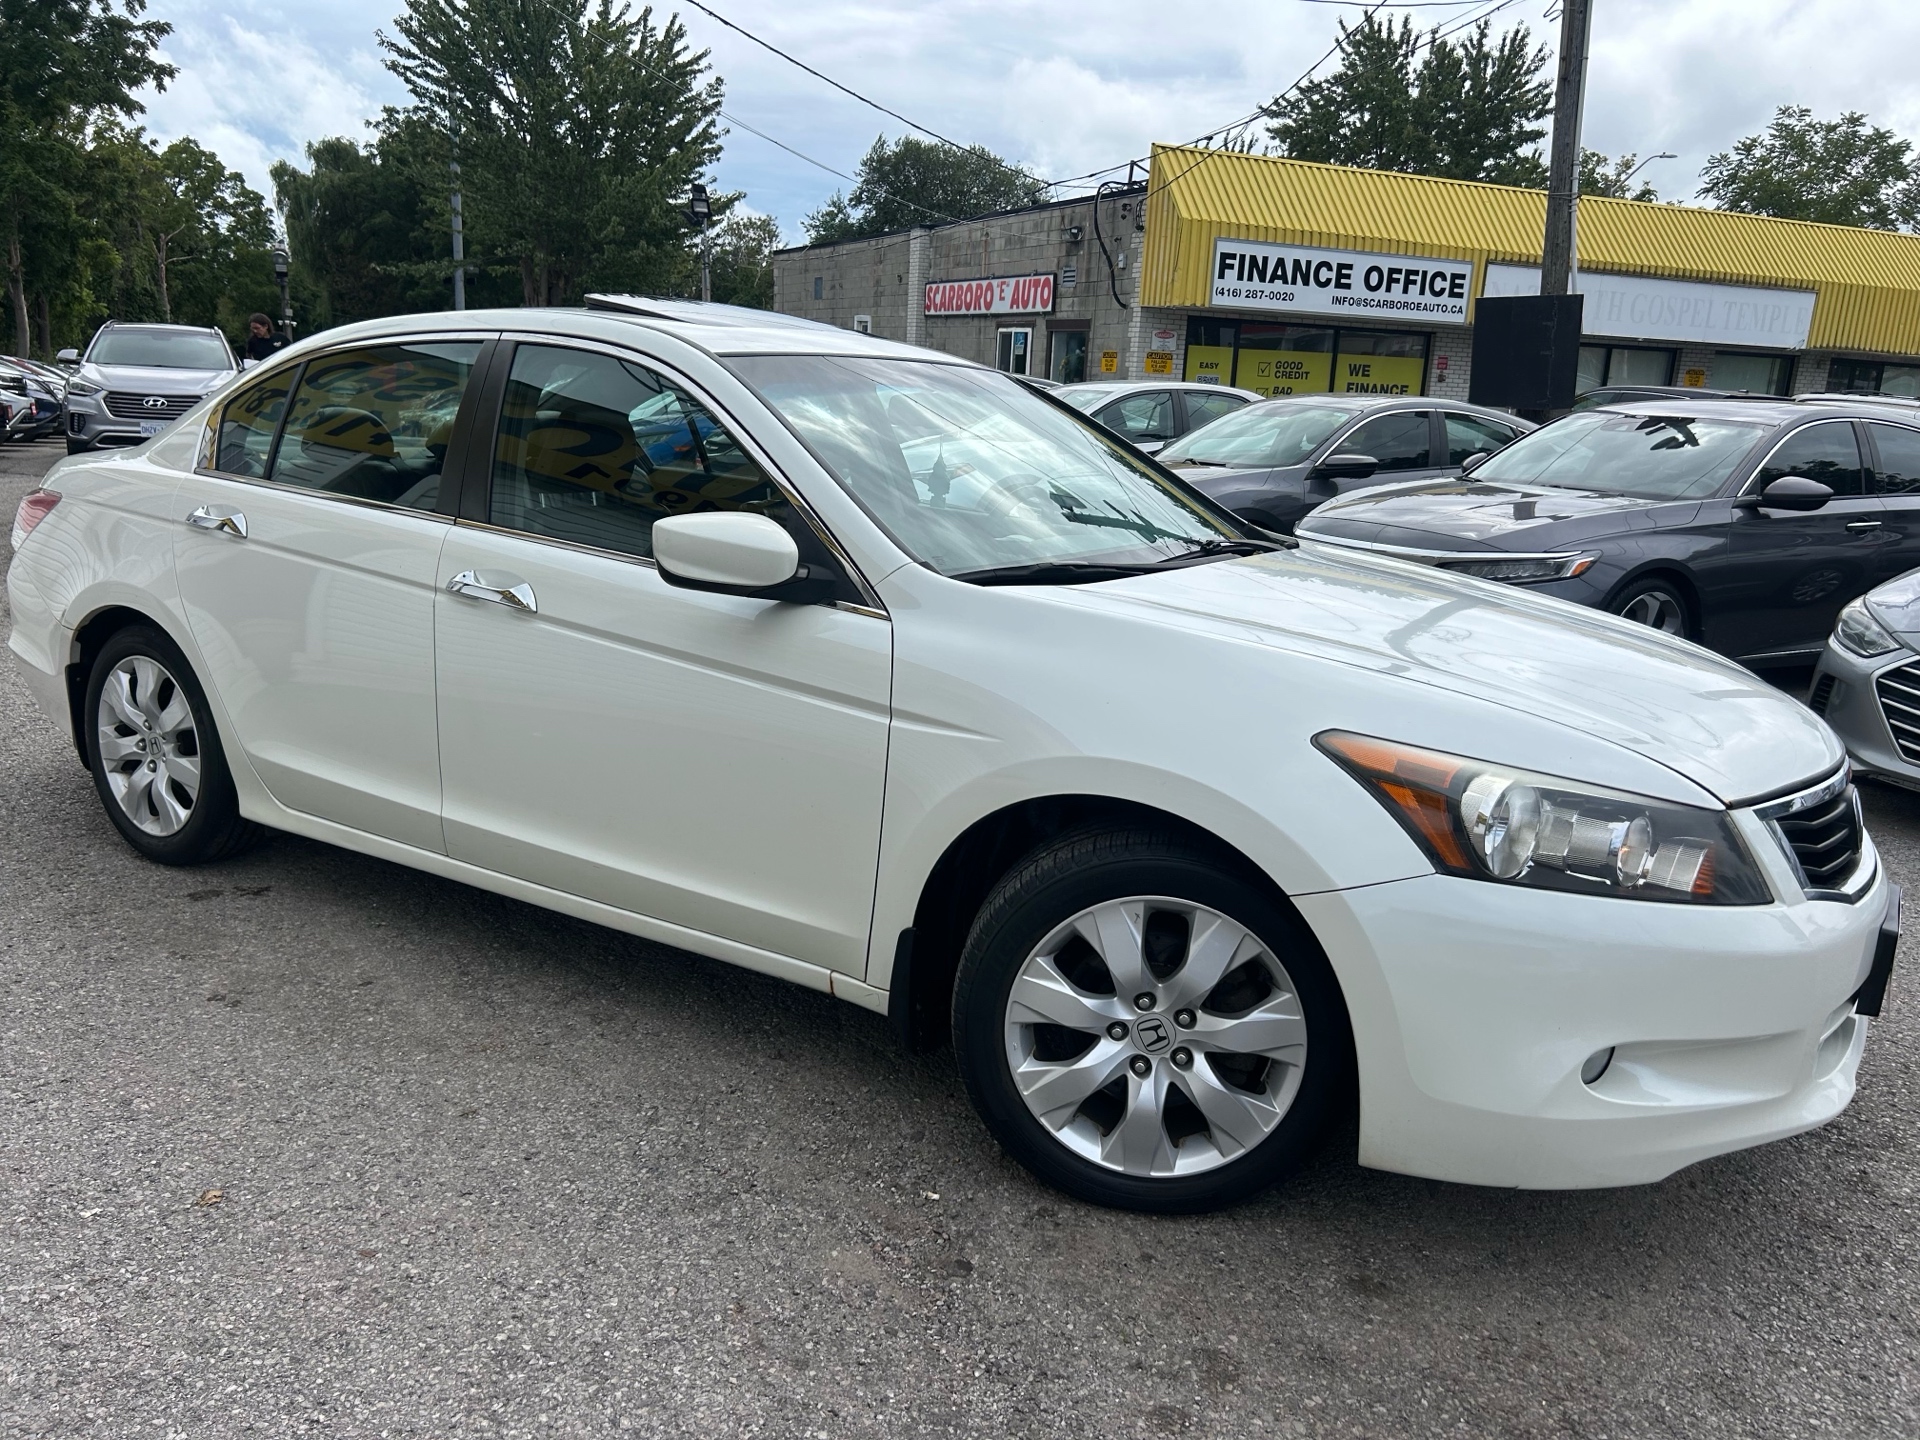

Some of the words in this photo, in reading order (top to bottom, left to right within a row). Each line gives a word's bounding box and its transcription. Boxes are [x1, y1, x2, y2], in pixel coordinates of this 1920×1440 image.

[1217, 252, 1354, 290] FINANCE
[1363, 265, 1467, 299] OFFICE
[925, 281, 994, 313] SCARBORO
[1009, 276, 1053, 310] AUTO
[1215, 286, 1242, 298] (416)
[1244, 288, 1295, 302] 287-0020
[1331, 295, 1464, 314] INFO@SCARBOROEAUTO.CA
[1723, 300, 1808, 336] TEMPLE
[1199, 361, 1219, 369] EASY
[1275, 361, 1303, 370] GOOD
[1348, 363, 1371, 377] WE
[1274, 370, 1310, 380] CREDIT
[1272, 386, 1293, 395] BAD
[1346, 382, 1409, 395] FINANCE
